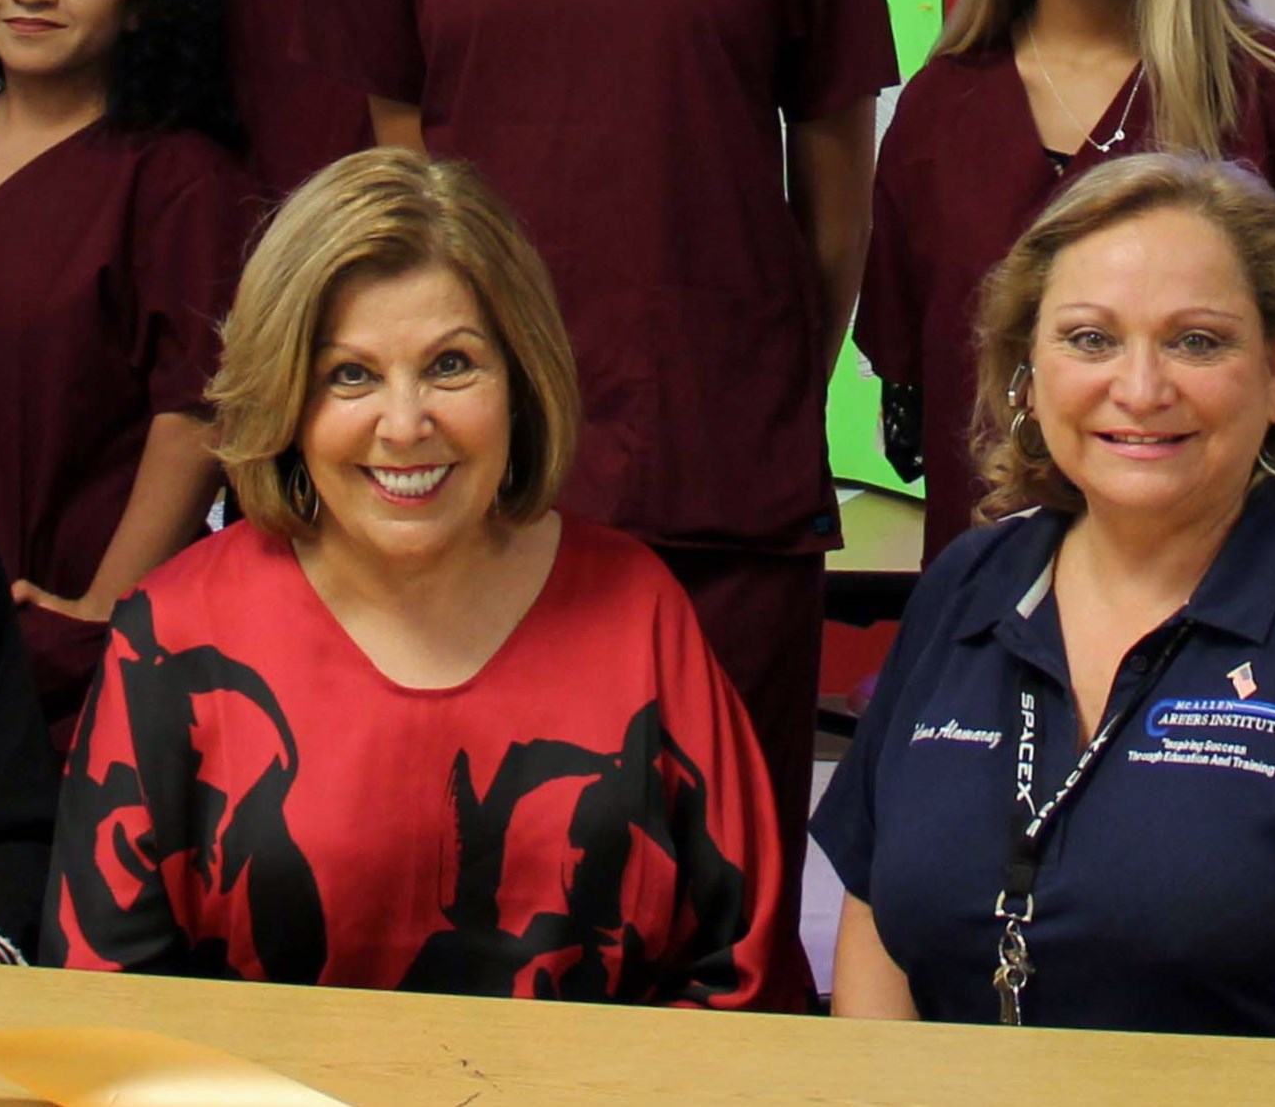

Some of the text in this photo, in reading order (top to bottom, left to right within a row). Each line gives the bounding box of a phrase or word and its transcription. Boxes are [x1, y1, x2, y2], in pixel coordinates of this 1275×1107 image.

[1016, 692, 1036, 816] SPACEX
[1163, 753, 1209, 766] Education
[1210, 754, 1231, 767] And
